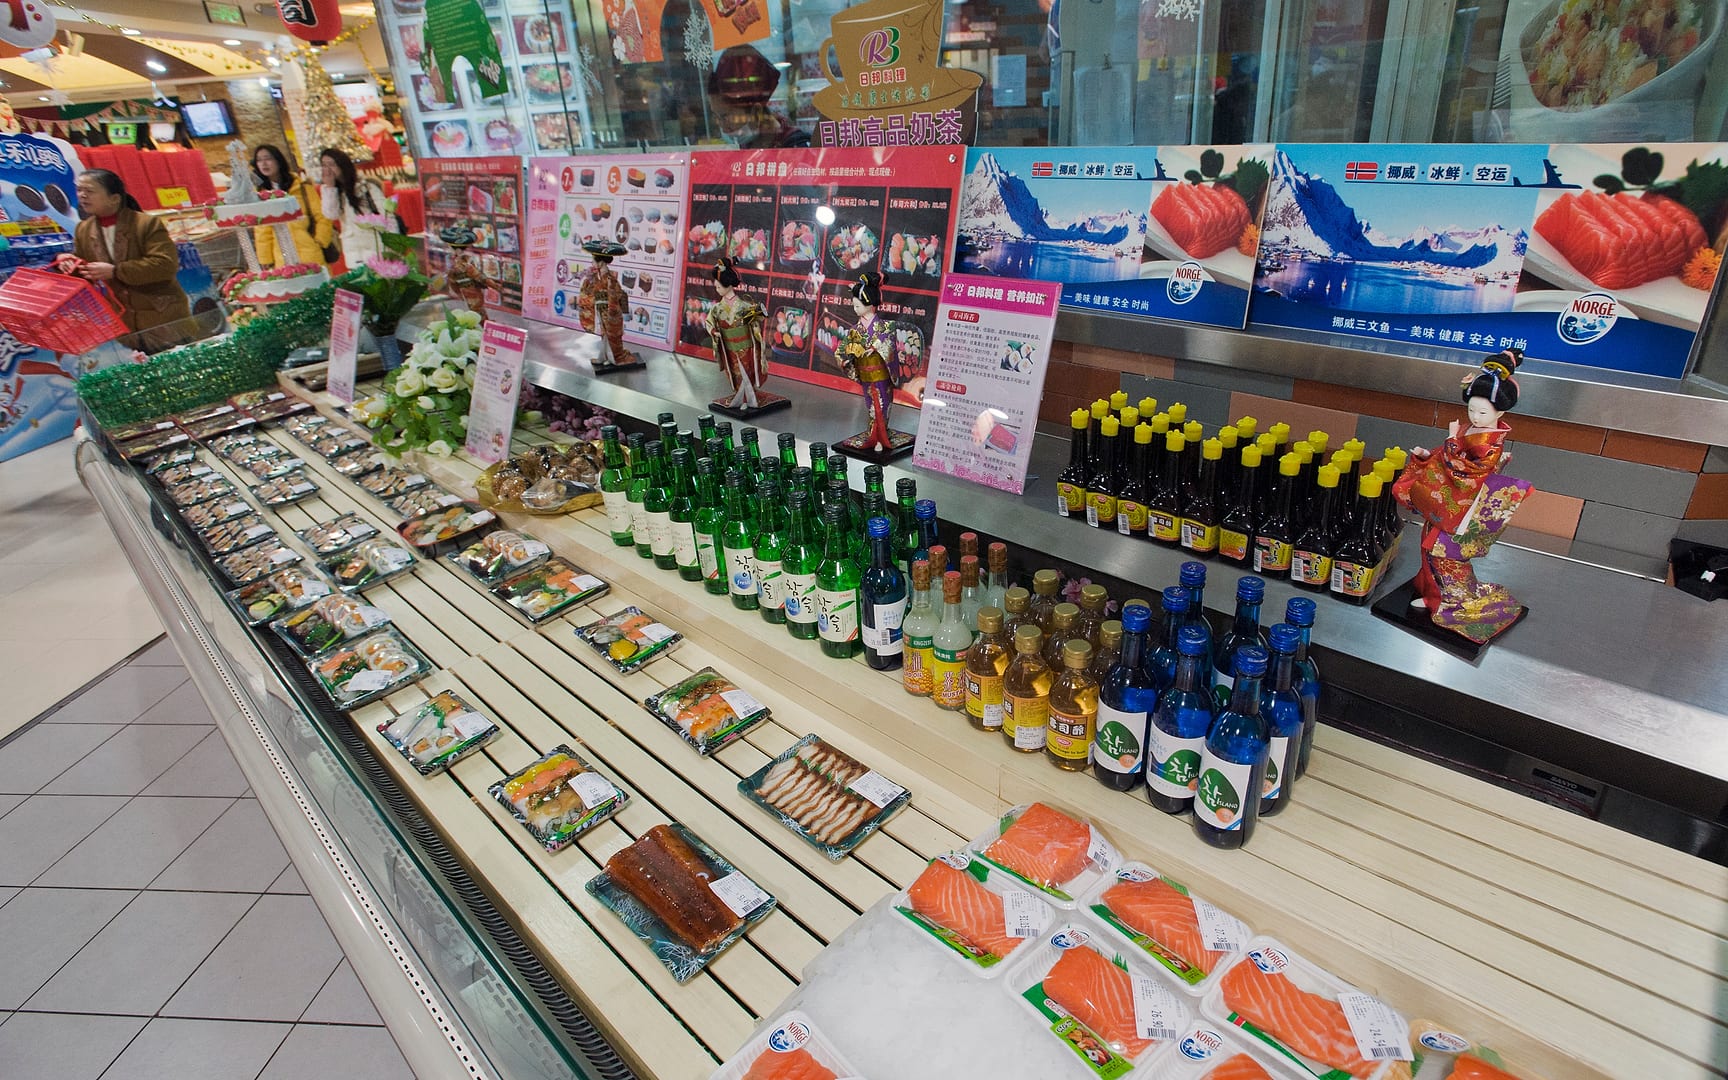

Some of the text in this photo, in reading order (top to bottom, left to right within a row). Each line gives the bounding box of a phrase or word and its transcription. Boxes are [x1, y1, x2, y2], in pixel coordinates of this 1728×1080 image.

[860, 68, 906, 86] 日邦料理
[819, 110, 962, 147] 日邦高品奶茶
[1059, 165, 1133, 176] 挪威 冰鲜 空运
[1387, 165, 1507, 181] 挪威 冰鲜 空运
[1176, 268, 1202, 280] NORGE
[967, 286, 1004, 300] 日邦料理
[1074, 292, 1149, 311] 美味 健康 安全 时尚
[1572, 299, 1616, 316] NORGE
[1332, 315, 1527, 351] 挪威三文鱼 美味 健康 安全 时尚
[1551, 776, 1578, 790] SANYO
[1216, 797, 1239, 809] ISLAND
[1263, 947, 1288, 970] NORGE
[786, 1021, 808, 1043] NORGE
[1194, 1029, 1222, 1051] NORGE
[1436, 1030, 1469, 1050] NORGE
